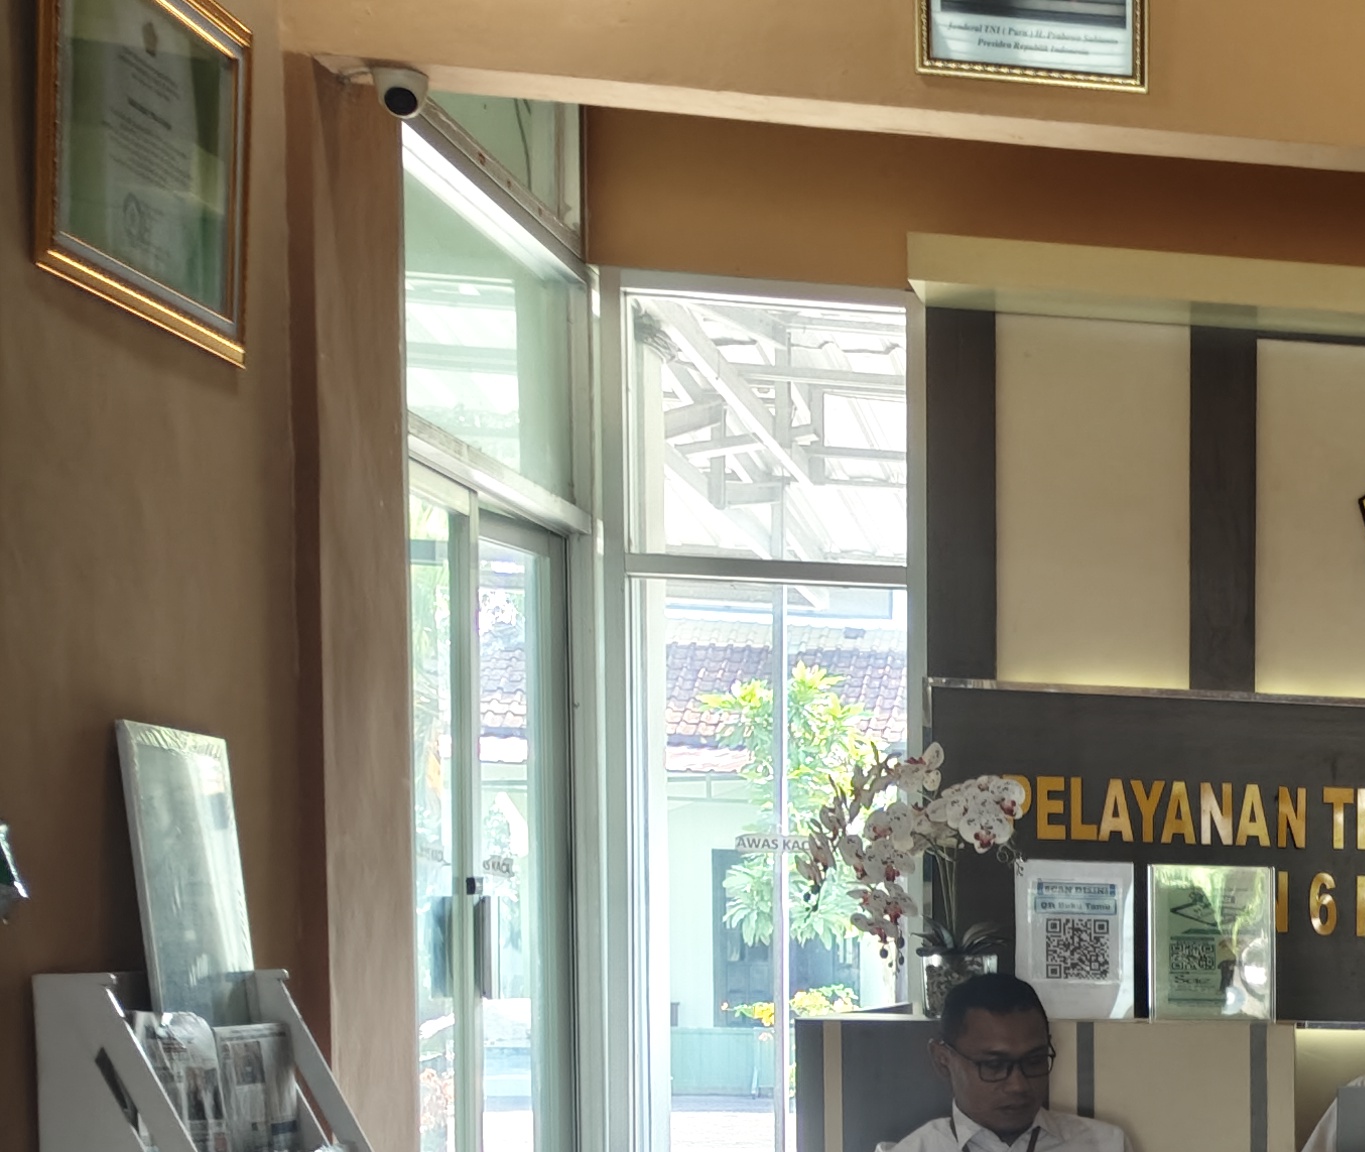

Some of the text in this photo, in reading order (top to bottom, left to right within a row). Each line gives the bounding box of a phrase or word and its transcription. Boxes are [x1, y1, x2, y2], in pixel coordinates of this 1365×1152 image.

[737, 837, 810, 851] AWAS KAC
[1309, 871, 1338, 937] 6
